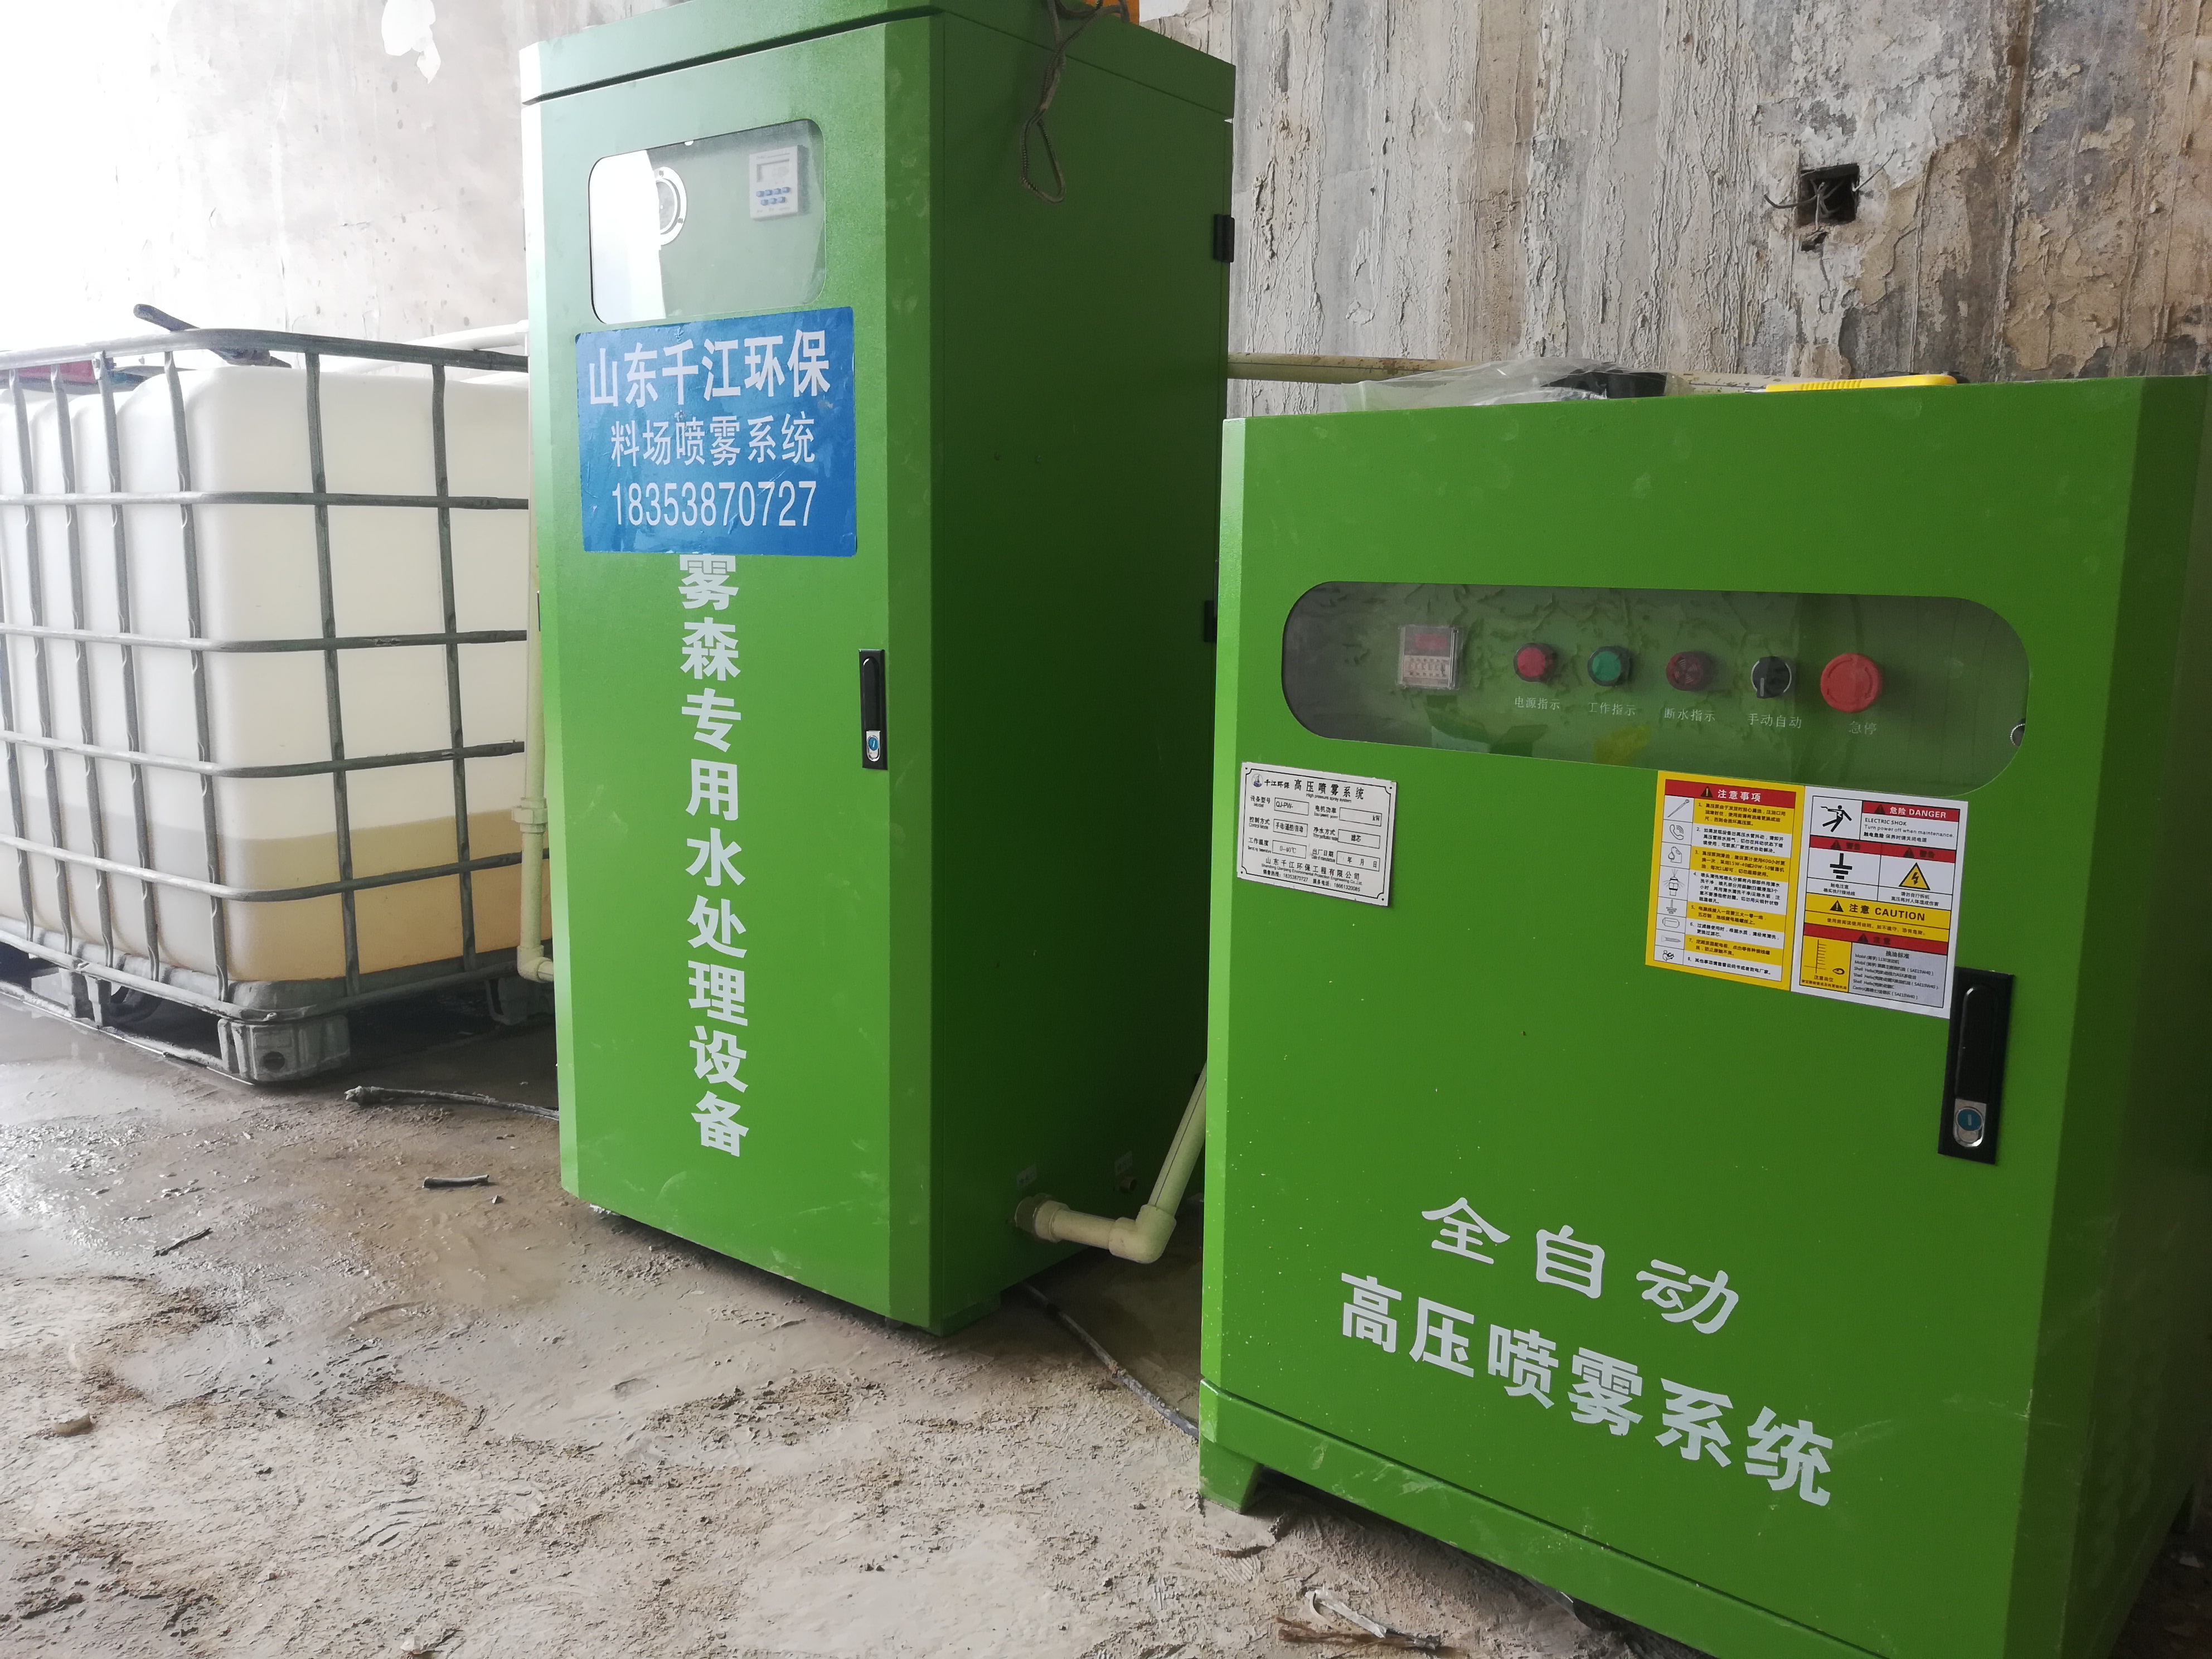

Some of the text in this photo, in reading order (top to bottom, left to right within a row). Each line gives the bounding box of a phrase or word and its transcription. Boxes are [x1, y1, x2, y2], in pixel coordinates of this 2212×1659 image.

[589, 329, 831, 407] 山东千江环保
[611, 413, 815, 466] 料场喷雾系统
[612, 481, 816, 526] 18353870727
[1515, 696, 1560, 710] 电源指示
[1588, 702, 1636, 716] 工作指示
[1664, 708, 1716, 722] 断水指示
[1747, 713, 1802, 729] 手动自动
[1849, 721, 1877, 735] 急停
[1264, 779, 1364, 799] 千江环保 高压喷雾系统
[1718, 789, 1761, 802] 注意事项
[1250, 795, 1270, 804] 设备型号
[1249, 816, 1270, 825] 控制方式
[1889, 806, 1946, 818] 危险 DANGER
[678, 554, 749, 1157] 雾森专用水处理设备
[1266, 857, 1360, 880] 山东千江环保工程有限公司
[1849, 903, 1925, 921] 注意 CAUTION
[1422, 1197, 1738, 1334] 全自动
[1341, 1273, 1833, 1506] 高压喷雾系统
